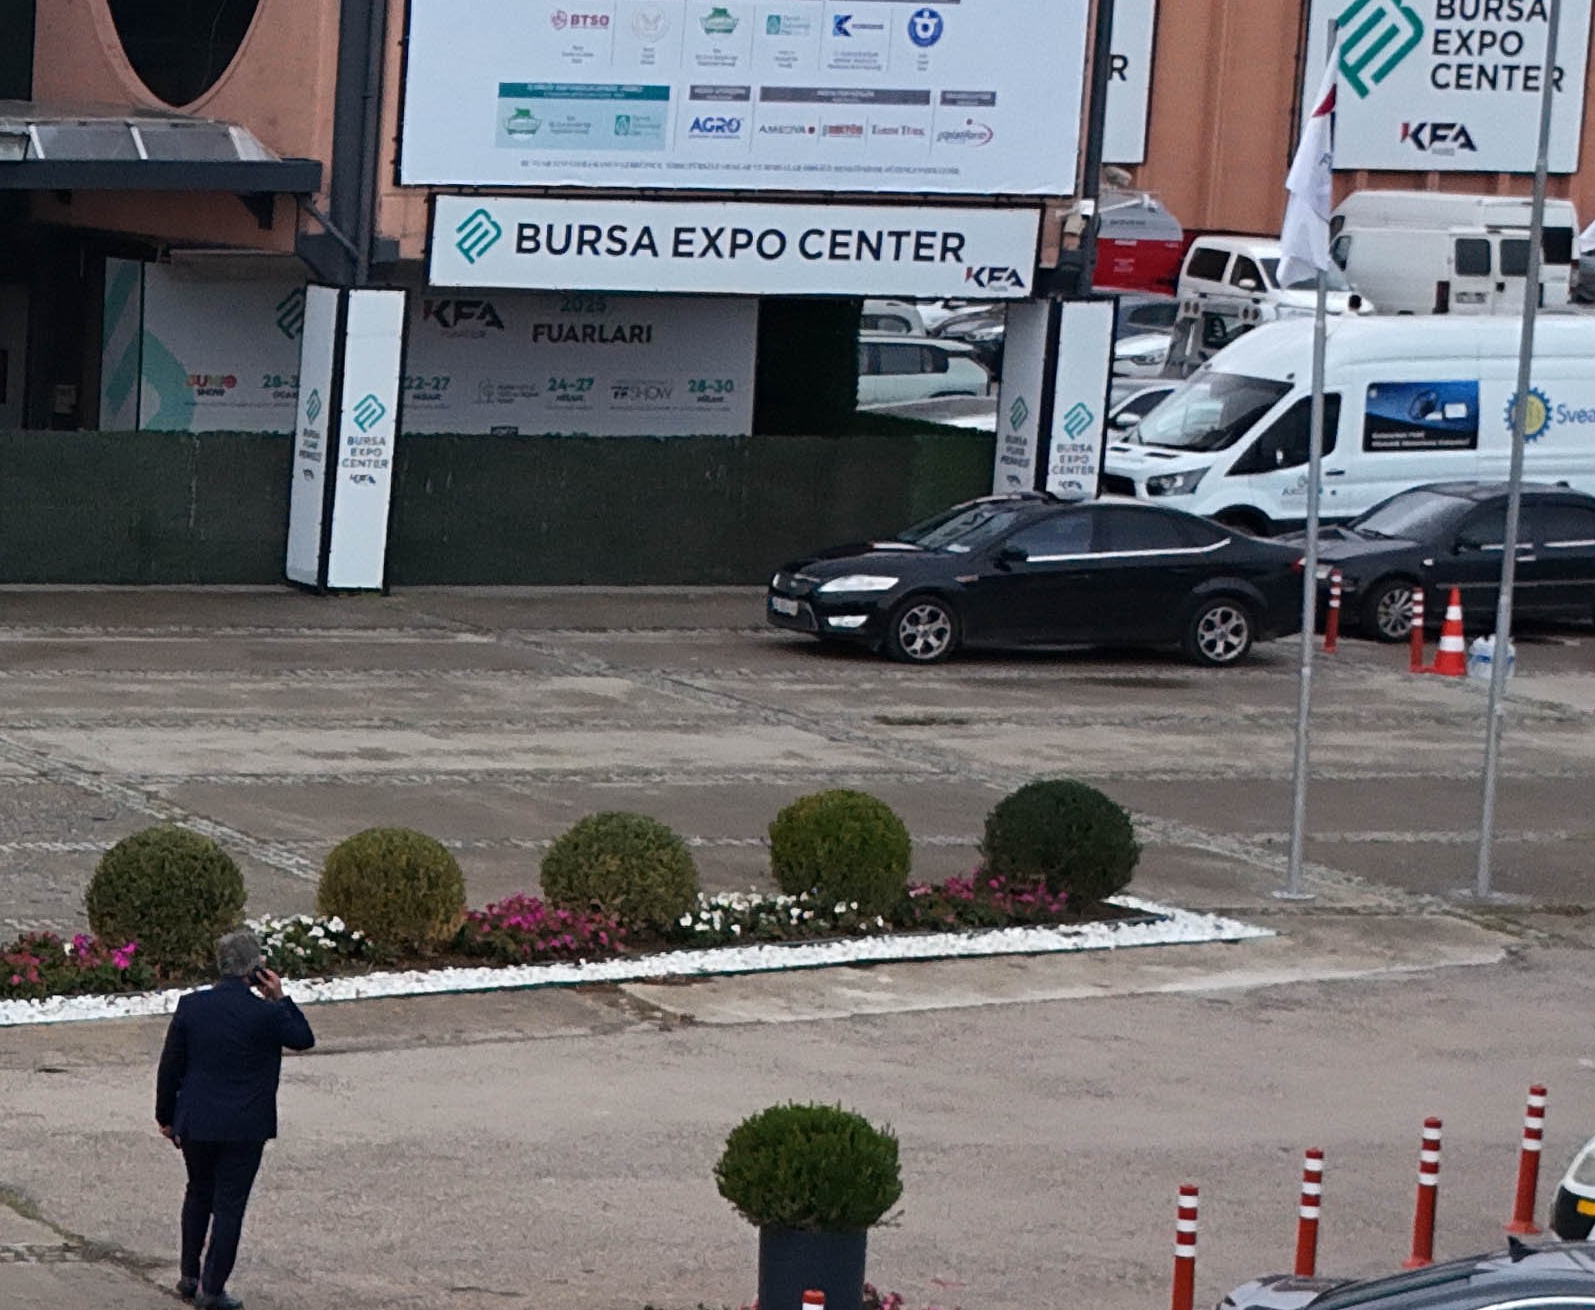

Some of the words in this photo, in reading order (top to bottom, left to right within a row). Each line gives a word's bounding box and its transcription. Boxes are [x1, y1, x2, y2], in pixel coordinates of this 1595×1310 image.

[571, 14, 609, 26] BTSO
[1432, 29, 1523, 57] EXPO
[1430, 63, 1564, 92] CENTER
[689, 117, 741, 133] AGRO
[1400, 122, 1477, 151] KFA
[515, 222, 659, 258] BURSA
[671, 227, 787, 260] EXPO
[798, 229, 965, 263] CENTER
[965, 266, 1025, 288] KFA
[560, 298, 606, 313] 2025
[423, 300, 504, 330] KFA
[532, 324, 652, 343] FUARLARI
[262, 374, 301, 388] 28-3
[547, 378, 594, 391] 24-27
[347, 436, 386, 446] BURSA
[1057, 444, 1093, 452] BURSA
[350, 448, 382, 457] EXPO
[1060, 455, 1089, 463] EXPO
[342, 458, 388, 468] CENTER
[1053, 466, 1095, 474] CENTER
